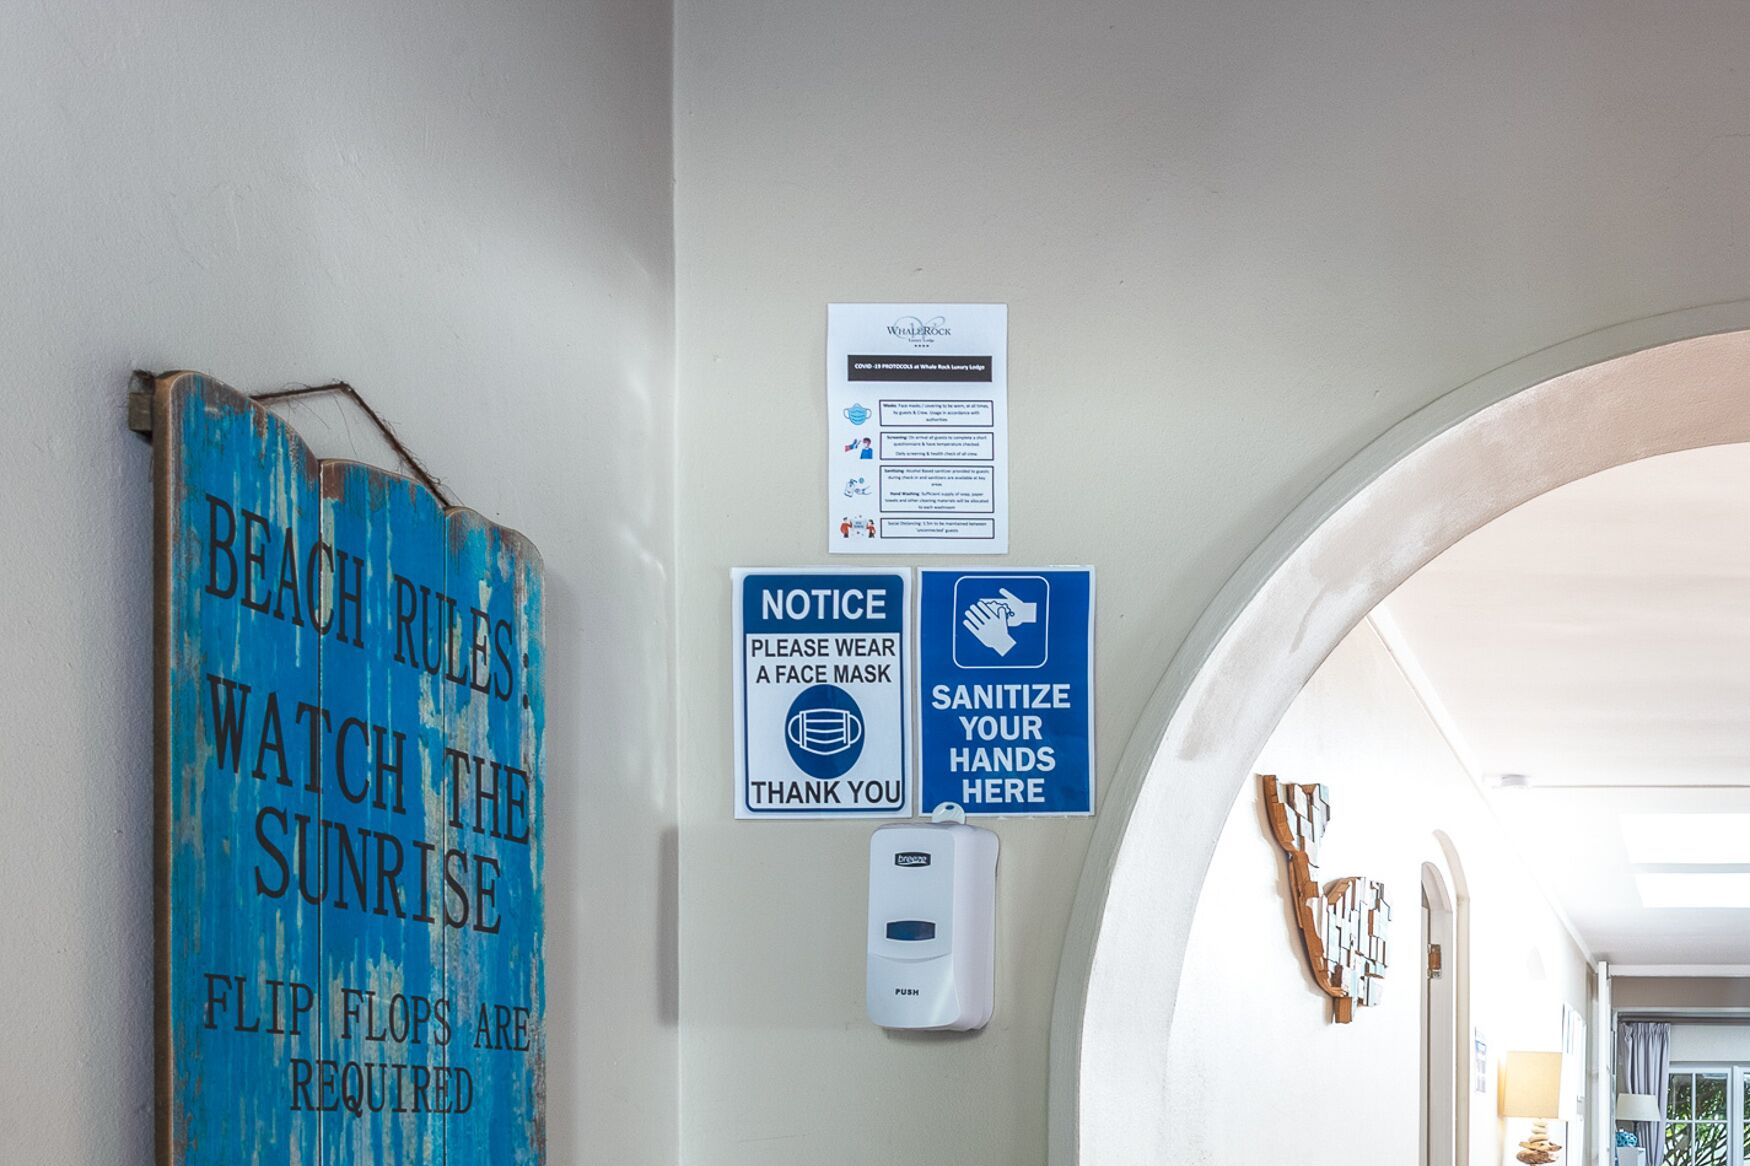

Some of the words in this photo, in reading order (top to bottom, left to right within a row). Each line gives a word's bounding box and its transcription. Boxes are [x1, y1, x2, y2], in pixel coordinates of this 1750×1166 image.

[854, 362, 872, 370] COVID
[882, 362, 913, 371] PROTOCOLS
[920, 363, 937, 371] Whale
[204, 493, 366, 650] BEACH
[393, 573, 532, 712] RULES:
[761, 588, 887, 620] NOTICE
[751, 638, 830, 658] PLEASE
[835, 638, 895, 657] WEAR
[756, 665, 770, 683] A
[776, 665, 827, 683] FACE
[834, 664, 892, 683] MASK
[932, 683, 1071, 709] SANITIZE
[959, 715, 1043, 741] YOUR
[206, 674, 407, 816] WATCH
[445, 745, 531, 847] THE
[949, 747, 1056, 772] HANDS
[751, 781, 841, 804] THANK
[847, 780, 901, 804] YOU
[962, 778, 1046, 804] HERE
[254, 805, 502, 935] SUNRISE
[895, 988, 920, 996] PUSH
[203, 973, 316, 1037] FLIP
[341, 986, 453, 1052] FLOPS
[473, 1003, 531, 1054] ARE
[290, 1057, 474, 1118] REQUIRED
